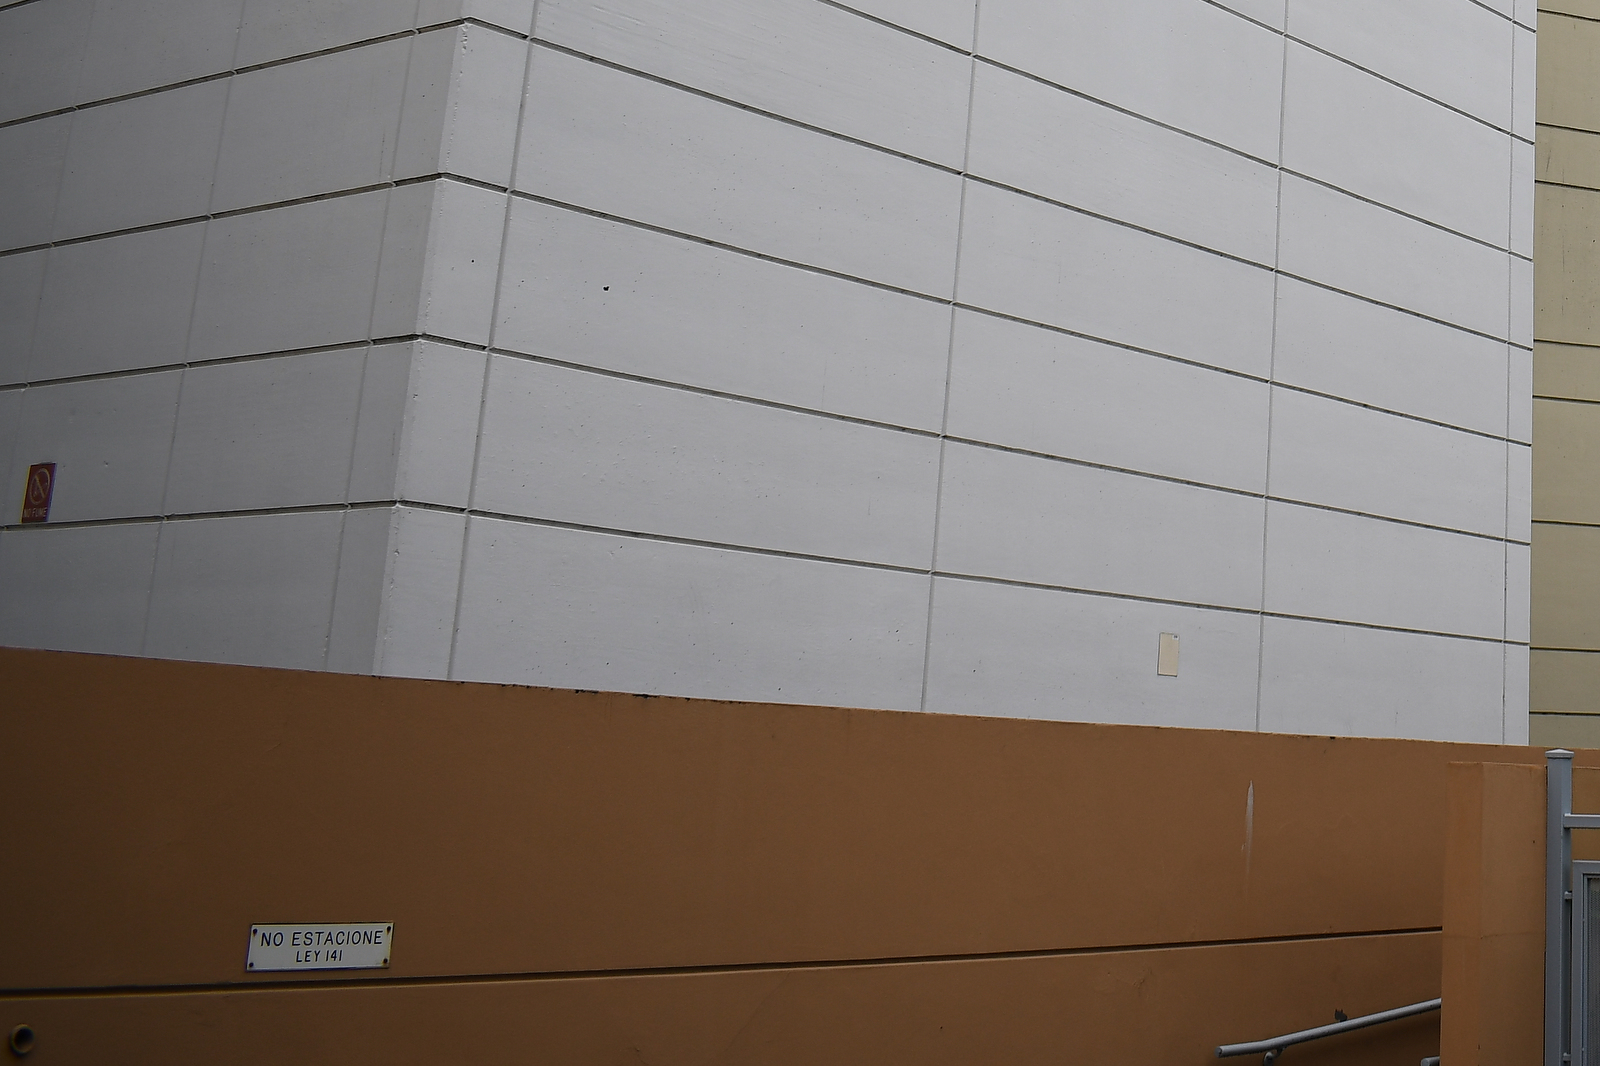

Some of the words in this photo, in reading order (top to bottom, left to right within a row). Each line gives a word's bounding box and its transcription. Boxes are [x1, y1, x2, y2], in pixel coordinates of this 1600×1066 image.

[260, 932, 284, 947] NO
[291, 930, 384, 947] ESTACIONE
[295, 950, 321, 962] LEY
[325, 949, 343, 962] 141
